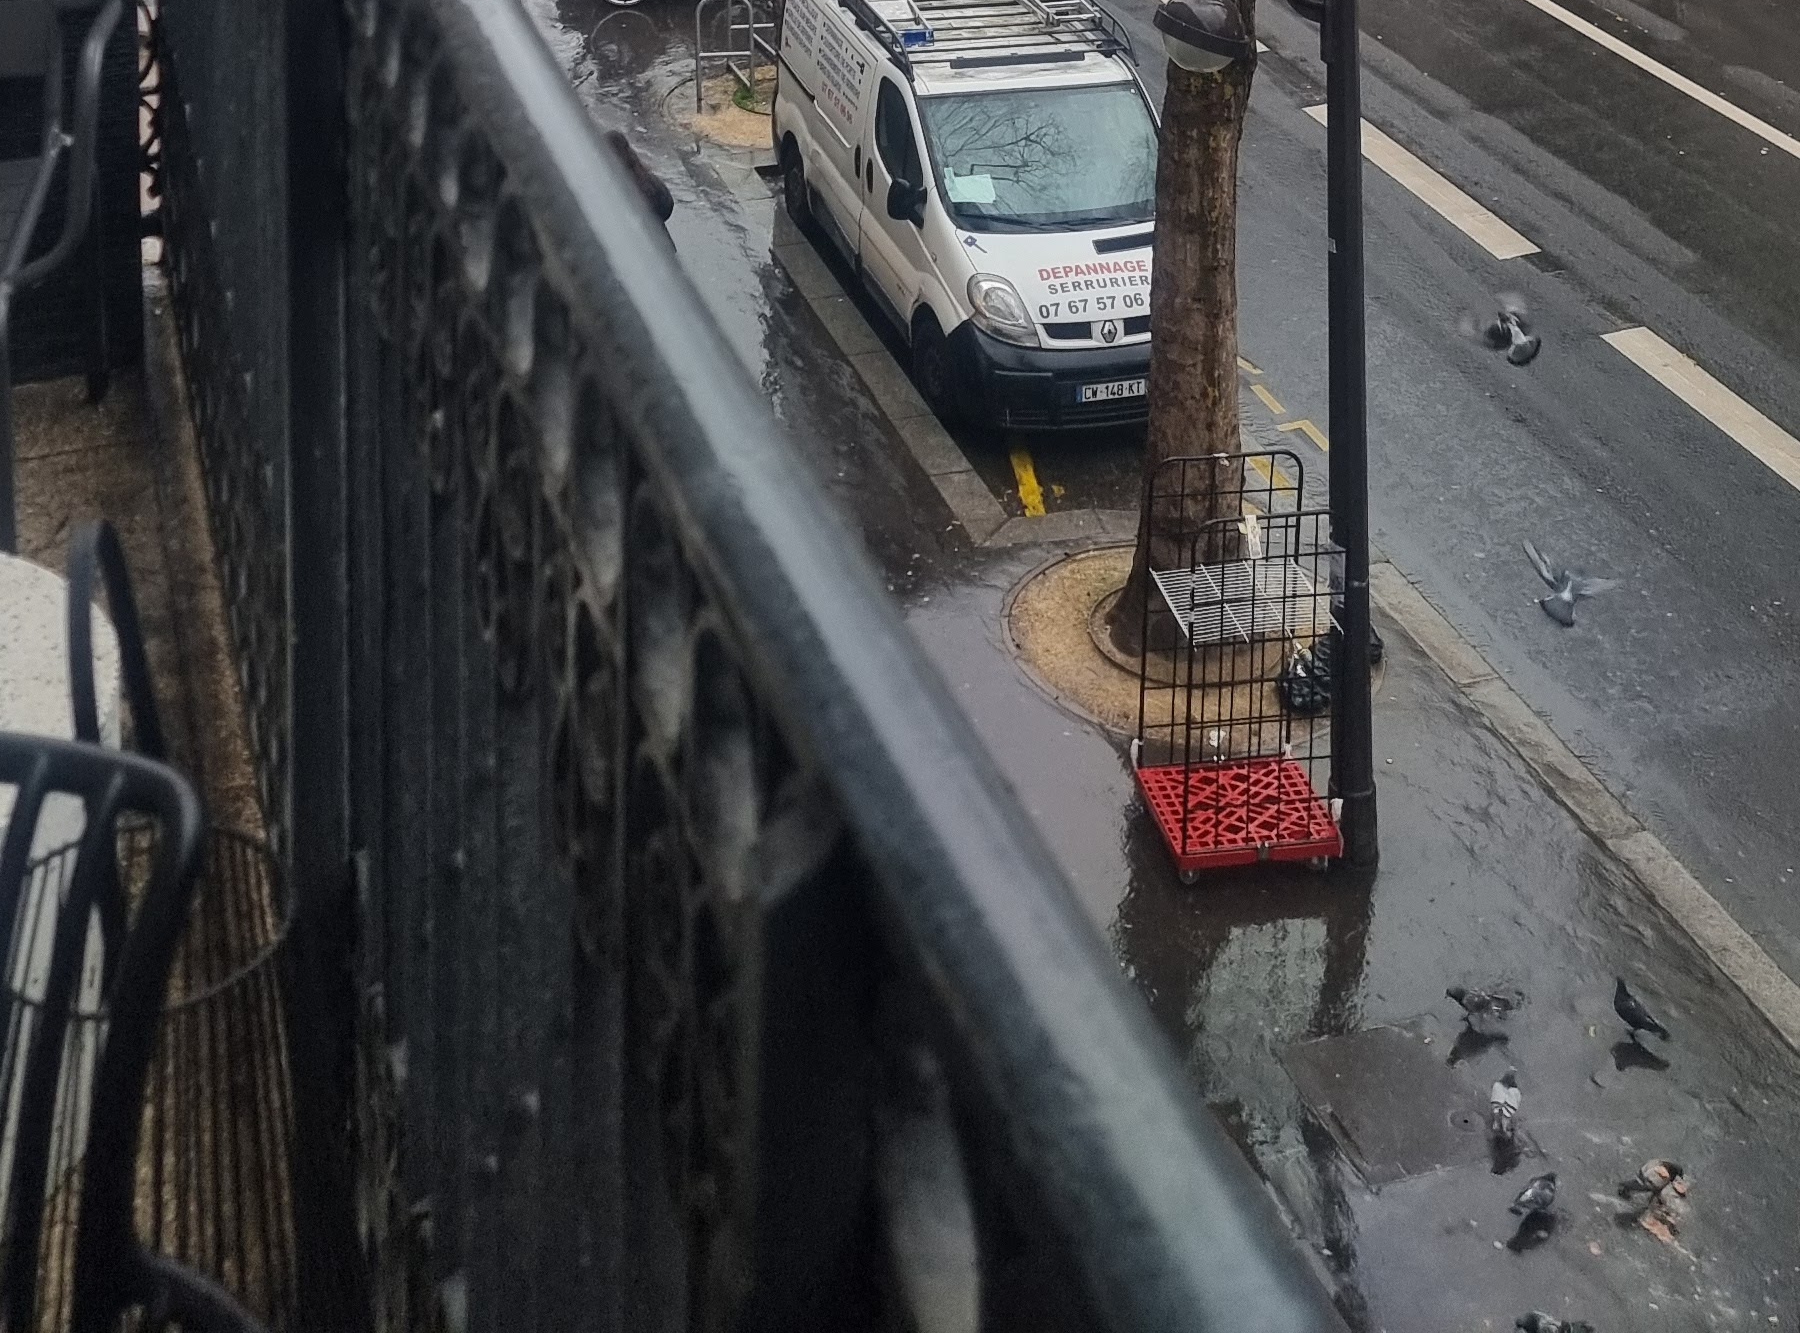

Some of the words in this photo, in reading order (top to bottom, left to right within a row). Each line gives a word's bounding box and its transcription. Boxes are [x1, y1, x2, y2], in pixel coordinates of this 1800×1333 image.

[1037, 259, 1149, 282] DEPANNAGE
[1047, 275, 1150, 295] SERRURIER
[1038, 302, 1061, 320] 07
[1067, 298, 1089, 315] 67
[1096, 295, 1117, 312] 57
[1122, 292, 1145, 309] 06
[1083, 381, 1143, 400] CW-148-KT
